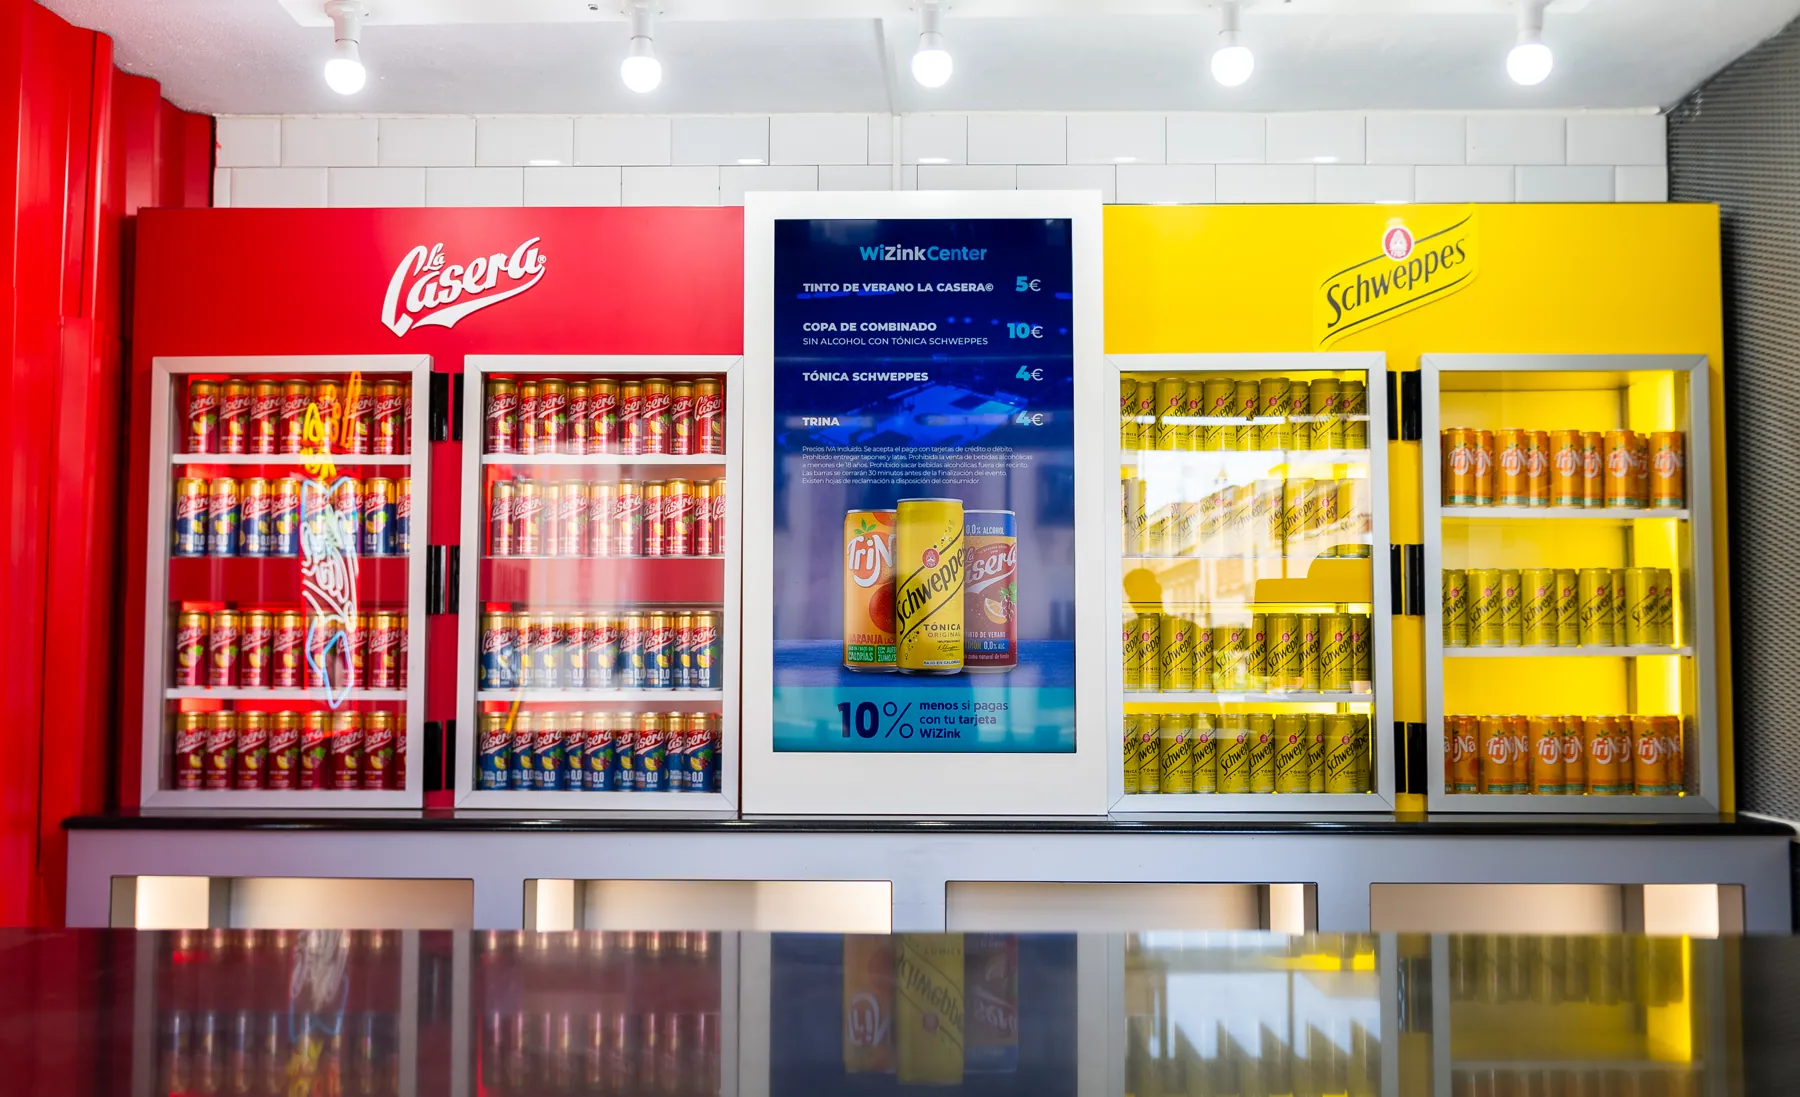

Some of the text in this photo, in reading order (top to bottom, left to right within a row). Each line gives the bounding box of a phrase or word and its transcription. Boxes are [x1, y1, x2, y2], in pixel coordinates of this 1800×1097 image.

[423, 242, 446, 272] La
[803, 283, 840, 292] TINTO
[842, 283, 860, 292] DE
[863, 283, 914, 292] VERANO
[917, 283, 933, 292] LA
[1015, 276, 1042, 292] 5€
[1326, 238, 1466, 328] Schweppes
[802, 322, 1044, 339] COPA DE COMBINADO 10€
[802, 335, 988, 346] SIN ALCOHOL CON TÓNICA SCHWEPPES
[802, 366, 1044, 382] TÓNICA SCHWEPPES 4€
[802, 410, 1044, 426] TRINA 4€
[982, 526, 1004, 534] ALCOHOL
[847, 534, 896, 587] TriN
[896, 547, 964, 636] Schweppe
[923, 622, 960, 630] TÓNICA
[920, 701, 1008, 714] menos si pagas
[838, 701, 914, 738] 10%
[920, 714, 996, 727] con tu tarjeta
[920, 728, 961, 738] WiZink
